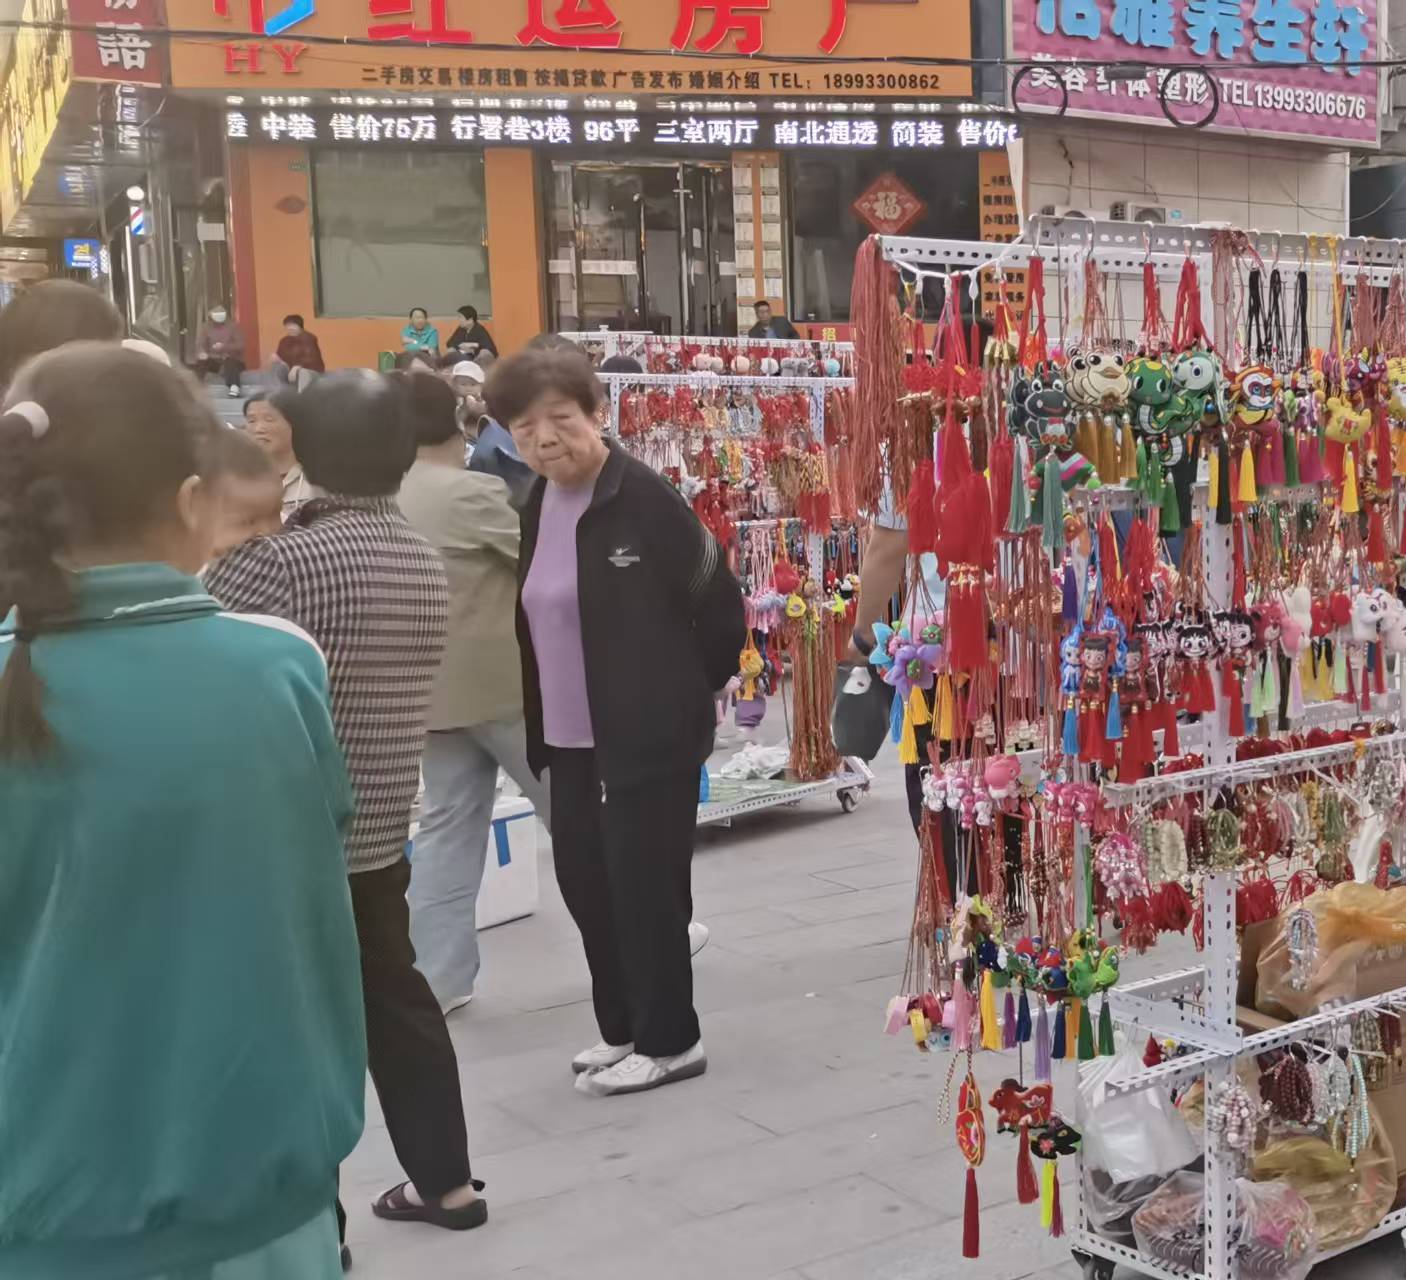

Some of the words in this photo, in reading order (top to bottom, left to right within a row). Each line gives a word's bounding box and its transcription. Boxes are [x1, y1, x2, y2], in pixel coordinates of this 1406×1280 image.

[223, 43, 310, 74] HY
[612, 69, 683, 90] 广告发布
[823, 73, 940, 91] 18993300862
[329, 113, 437, 142] 售价75万
[583, 117, 641, 143] 96平
[654, 118, 759, 145] 三室两厅
[774, 119, 878, 146] 南北通透
[891, 119, 945, 146] 简装
[872, 191, 902, 220] 福
